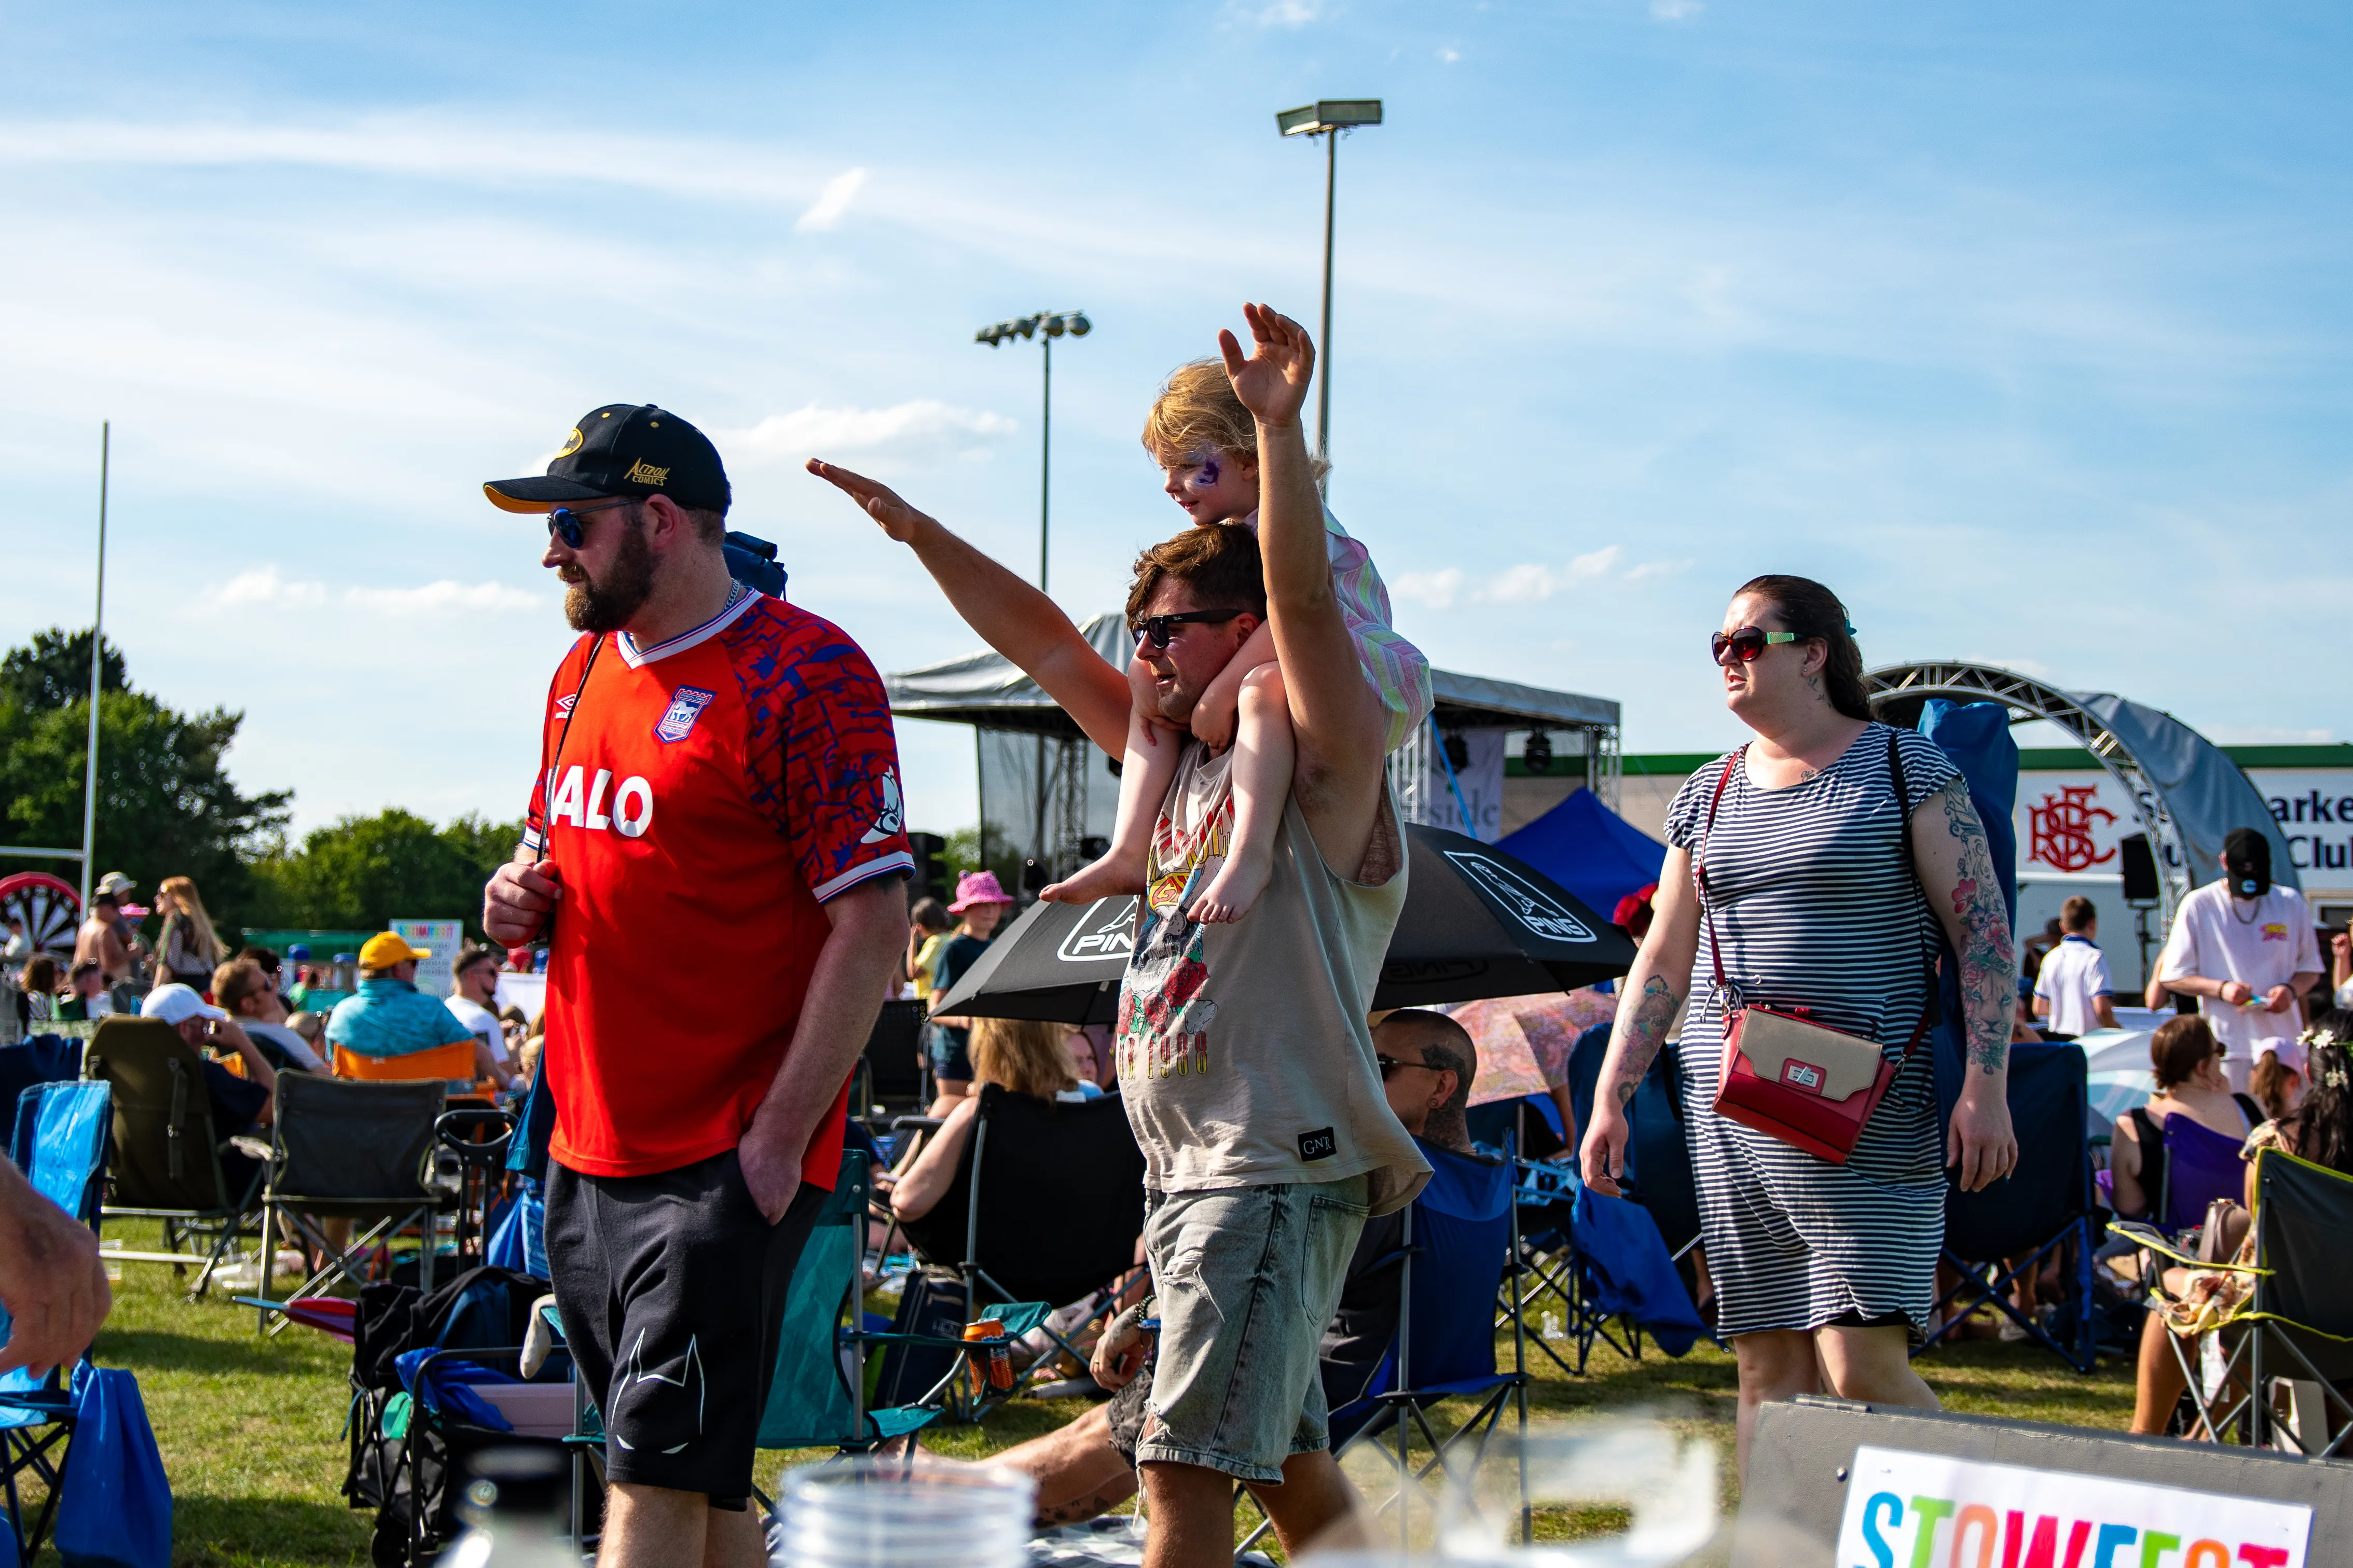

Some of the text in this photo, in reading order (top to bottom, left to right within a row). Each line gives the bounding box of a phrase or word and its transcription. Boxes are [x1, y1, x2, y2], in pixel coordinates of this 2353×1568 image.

[632, 476, 664, 486] COMICS
[2289, 836, 2353, 868] Clu
[1523, 915, 1587, 936] PING
[1148, 1031, 1208, 1079] 1988
